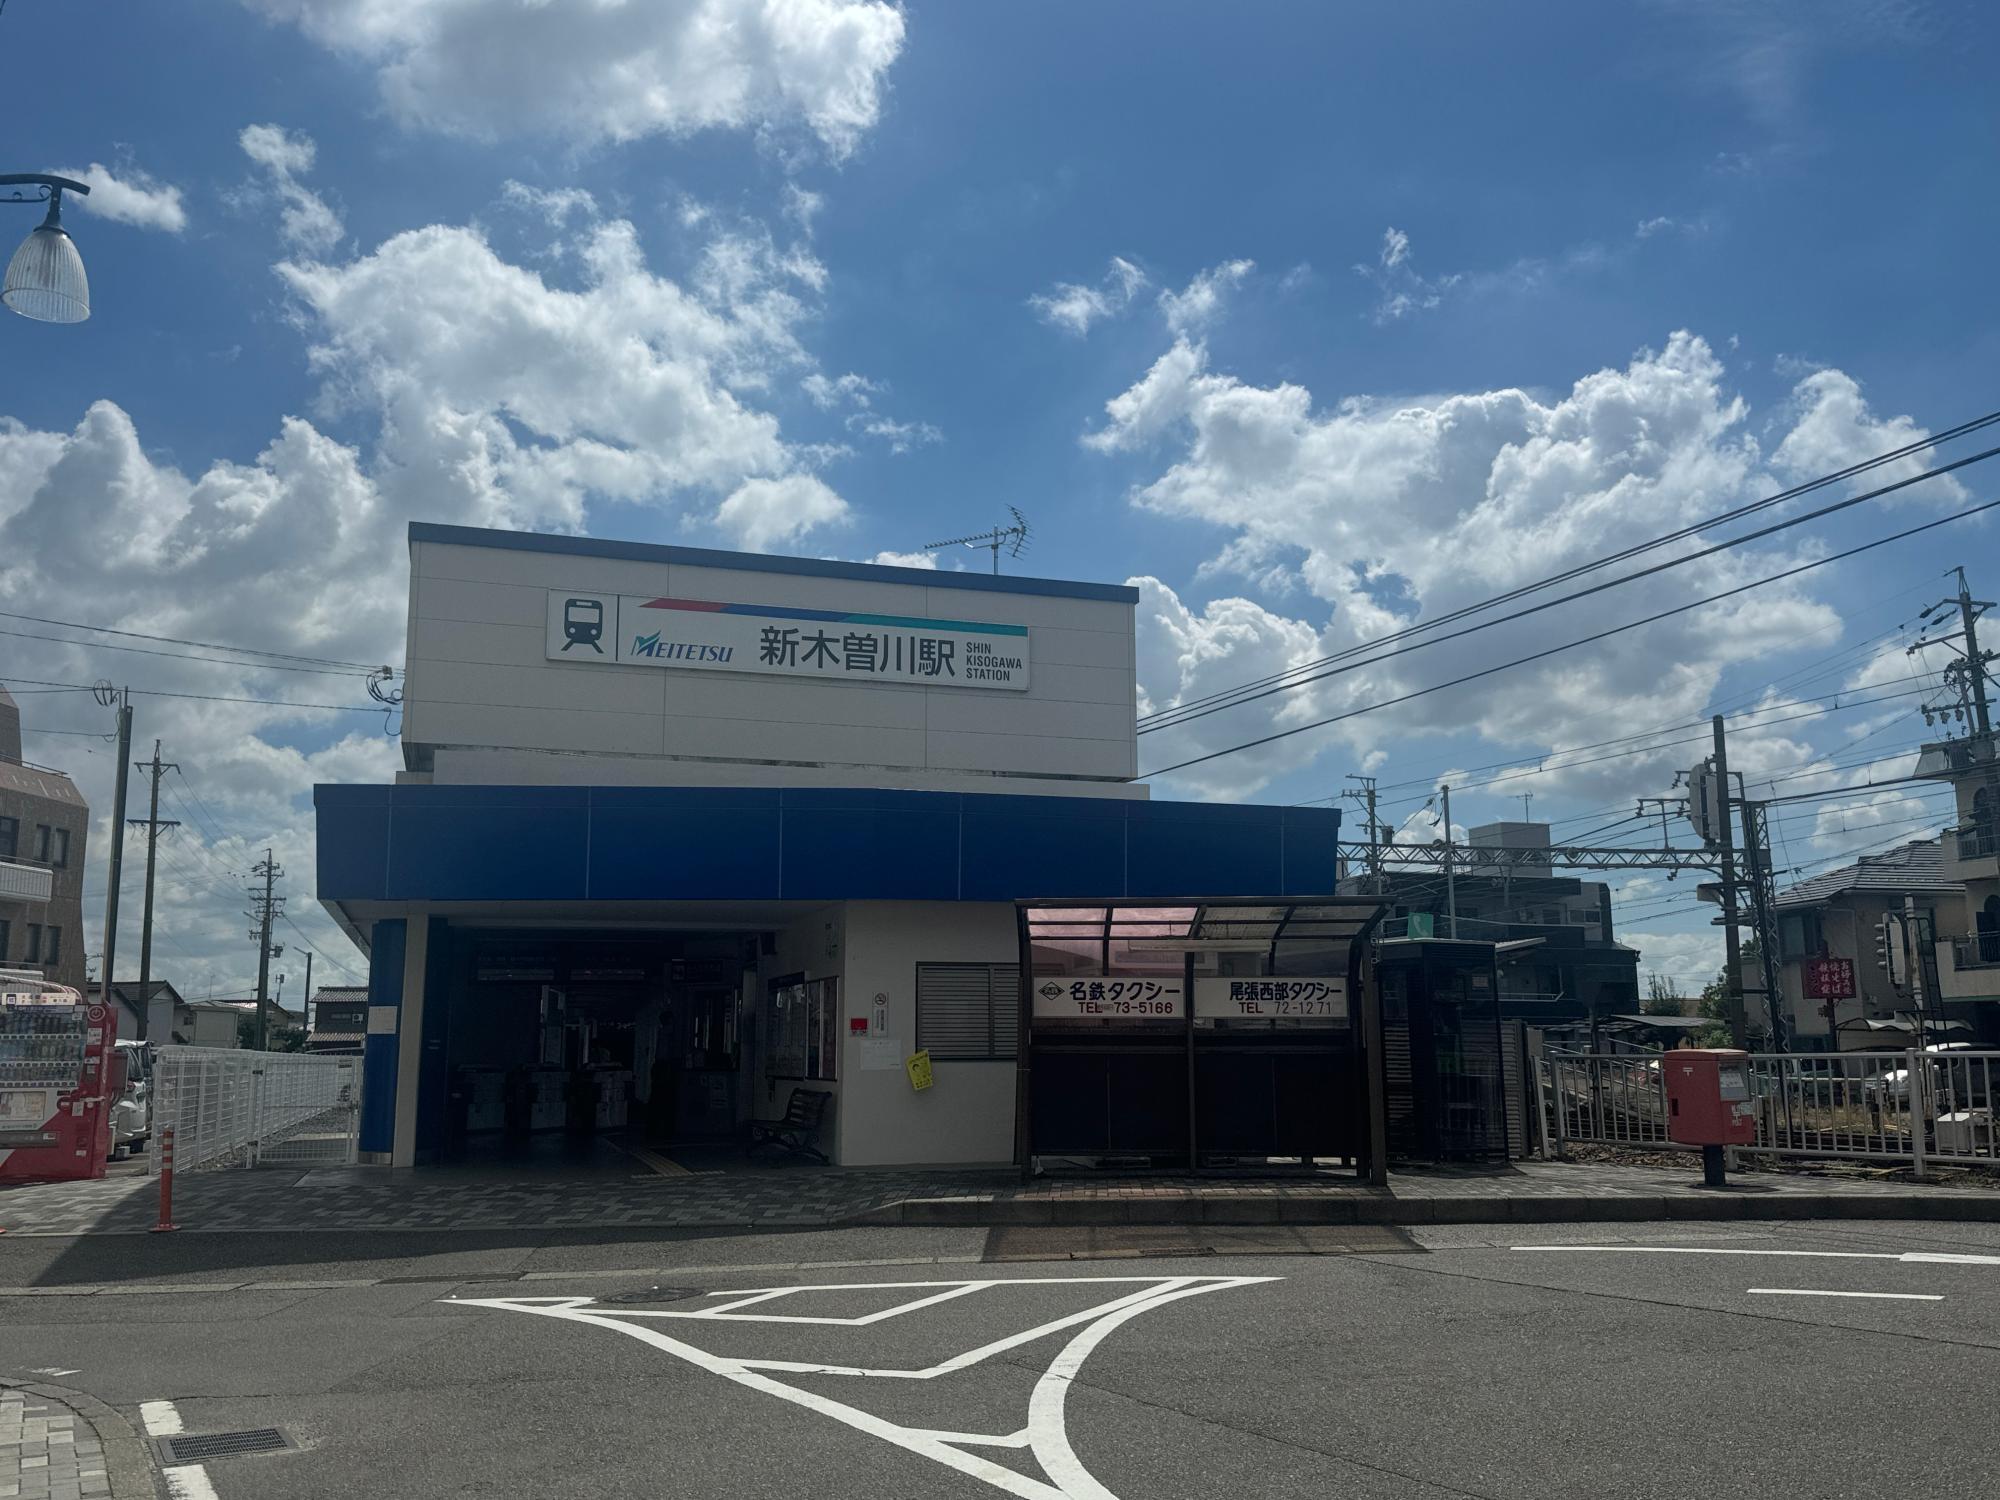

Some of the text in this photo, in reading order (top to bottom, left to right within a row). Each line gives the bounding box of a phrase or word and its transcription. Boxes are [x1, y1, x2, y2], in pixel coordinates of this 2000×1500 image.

[631, 630, 734, 663] MEITETSU
[759, 625, 955, 677] 新木曽川駅
[966, 642, 992, 654] SHIN
[966, 655, 1022, 670] KISOGAWA
[966, 668, 1011, 681] STATION
[1069, 981, 1181, 1001] 名鉄タクシー
[1229, 981, 1343, 1001] 尾張西部タクシー
[1078, 1001, 1103, 1014] TEL
[1113, 1001, 1173, 1014] 73-5166
[1239, 1001, 1264, 1014] TEL
